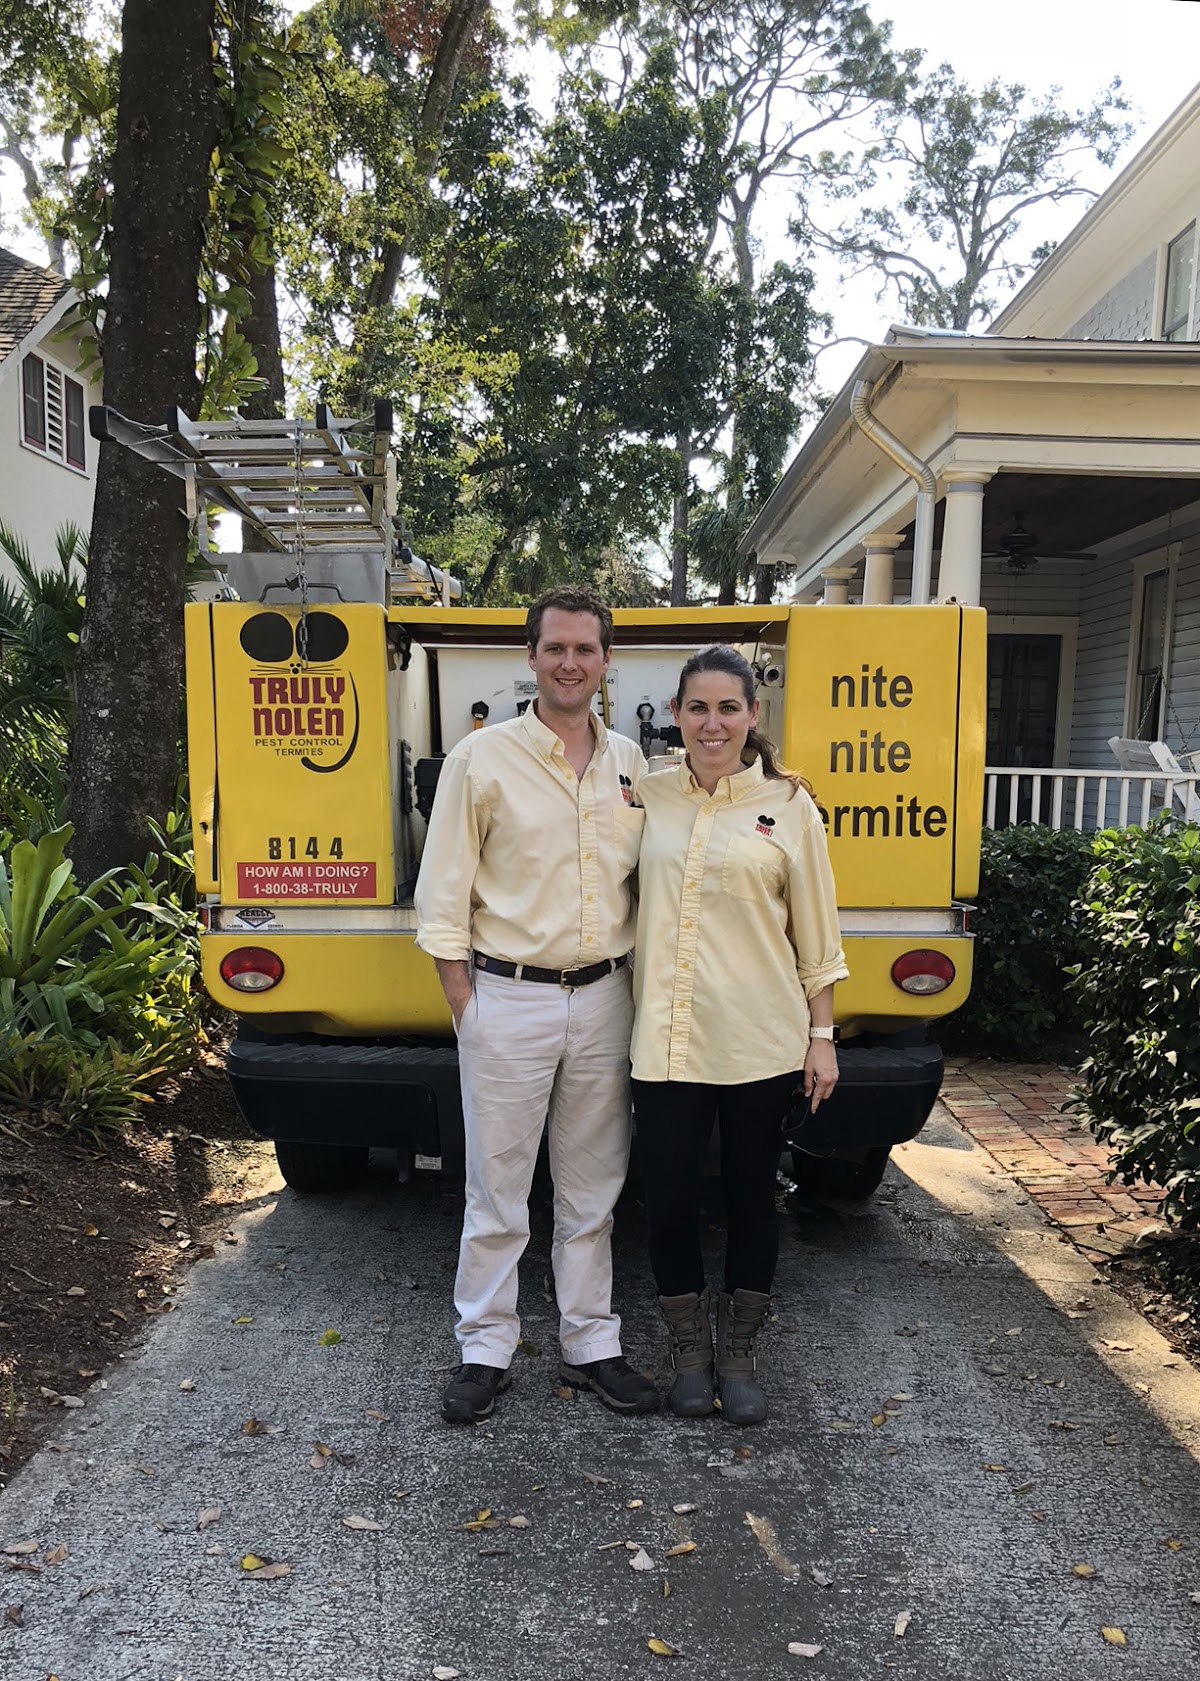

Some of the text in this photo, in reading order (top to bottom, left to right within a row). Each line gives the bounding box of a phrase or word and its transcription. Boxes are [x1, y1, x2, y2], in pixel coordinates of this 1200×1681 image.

[249, 677, 345, 704] TRULY
[831, 664, 913, 708] nite
[253, 708, 344, 736] NOLEN
[255, 738, 342, 746] PEST CONTROL
[275, 748, 323, 756] TERMITES
[830, 730, 911, 773] nite
[816, 795, 947, 837] ermite
[269, 837, 343, 859] 8144
[245, 866, 369, 877] HOW AM I DOING?
[253, 883, 358, 894] 1-800-38-TRULY
